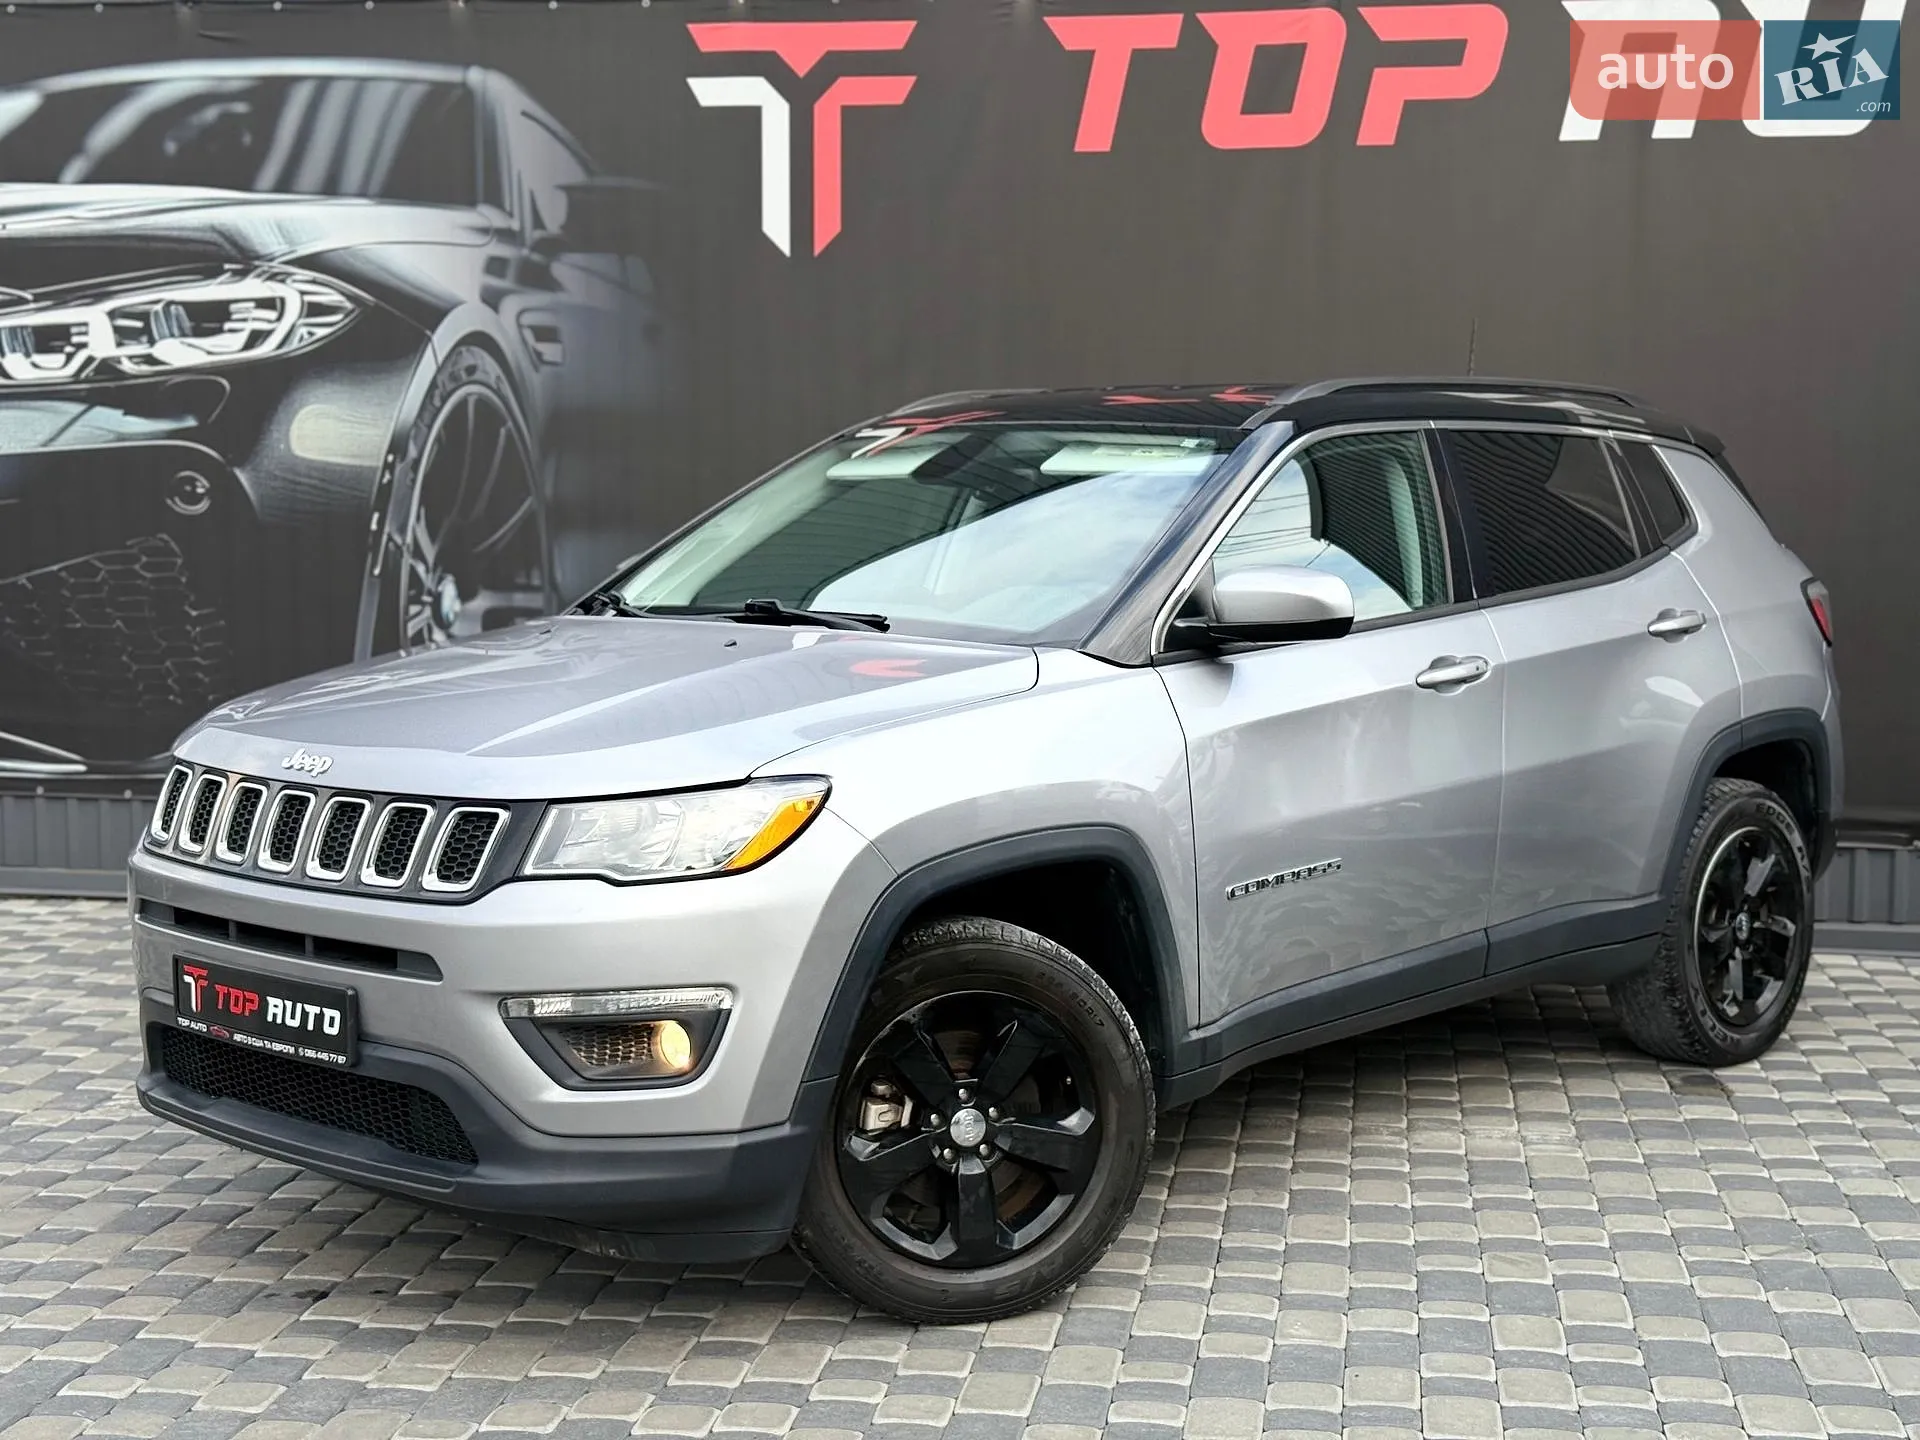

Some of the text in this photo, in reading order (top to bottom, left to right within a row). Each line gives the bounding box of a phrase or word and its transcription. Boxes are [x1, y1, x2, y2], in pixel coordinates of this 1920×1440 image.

[1043, 2, 1509, 153] TOP
[281, 747, 334, 777] Jeep
[1225, 857, 1343, 901] COMPASS
[176, 1016, 208, 1033] TOP AUTO
[214, 983, 342, 1037] TOP AUTO
